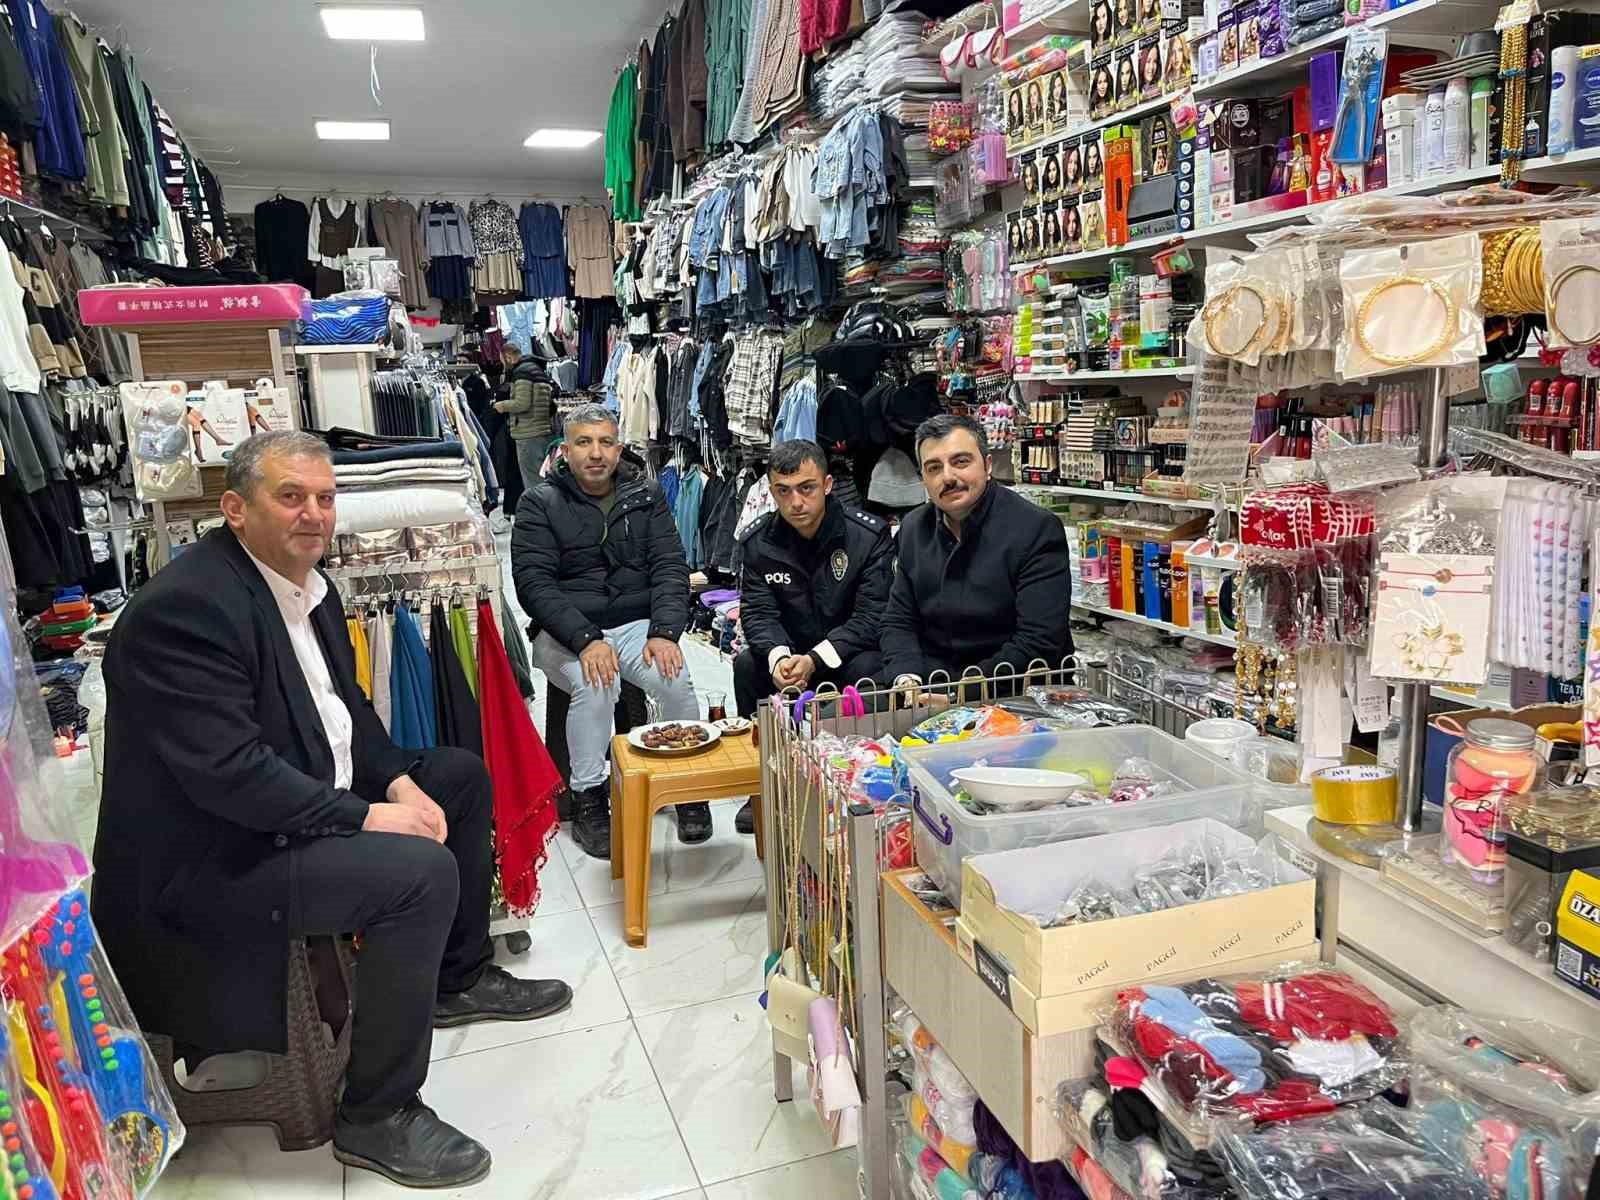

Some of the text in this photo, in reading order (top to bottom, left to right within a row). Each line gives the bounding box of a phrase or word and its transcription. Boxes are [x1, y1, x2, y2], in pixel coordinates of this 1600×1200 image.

[1559, 683, 1575, 695] TEA
[1211, 932, 1243, 959] PAGGI
[1274, 920, 1305, 945] PAGGI
[1077, 959, 1110, 985] PAGGI
[1146, 946, 1177, 972] PAGGI
